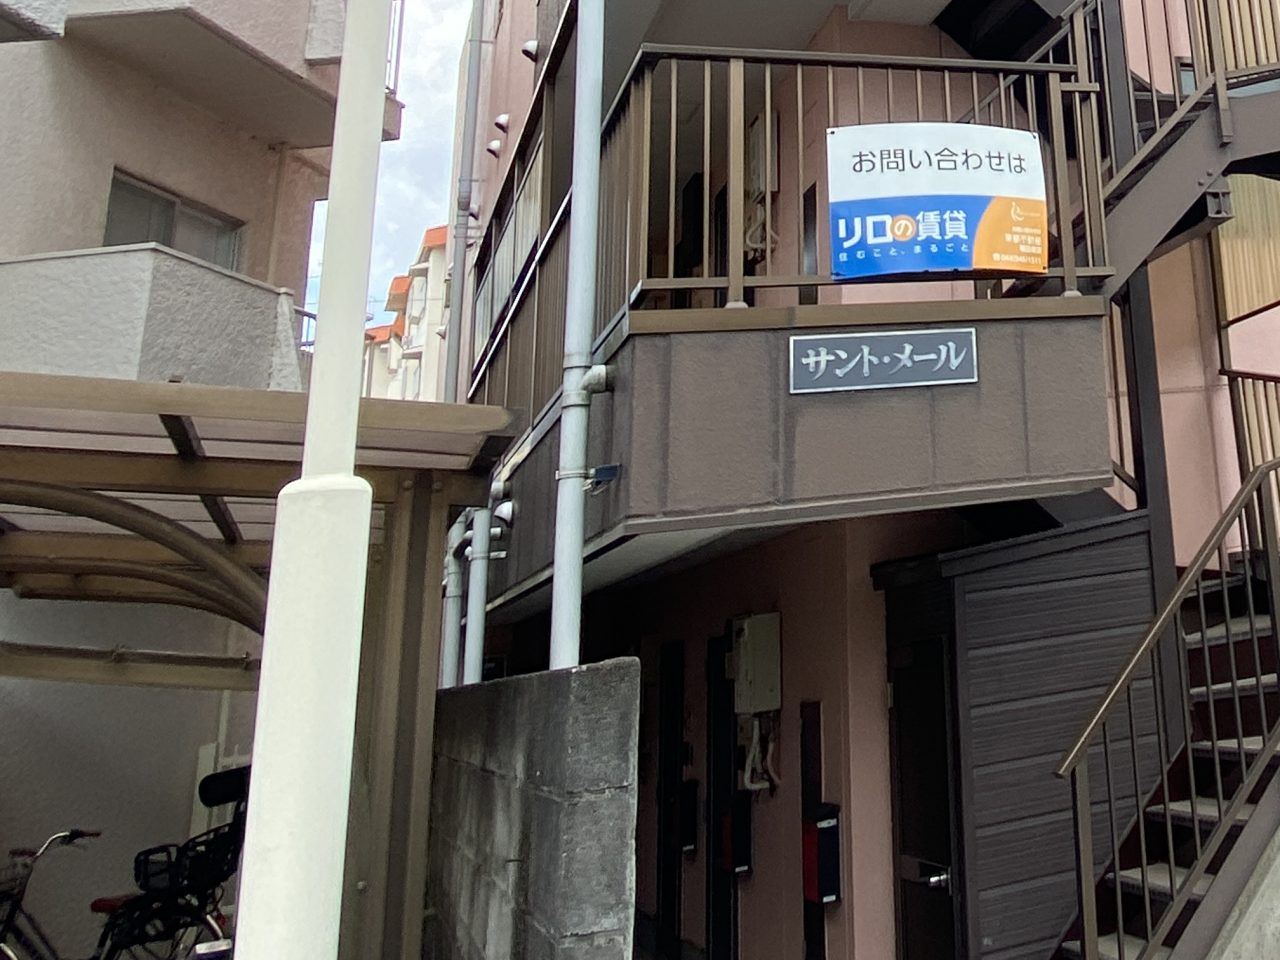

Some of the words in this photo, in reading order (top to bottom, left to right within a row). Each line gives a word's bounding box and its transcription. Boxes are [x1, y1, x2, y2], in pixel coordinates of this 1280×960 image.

[851, 147, 1027, 174] お問い合わせは
[838, 210, 969, 249] リロの賃貸
[801, 341, 967, 380] サント・メール
